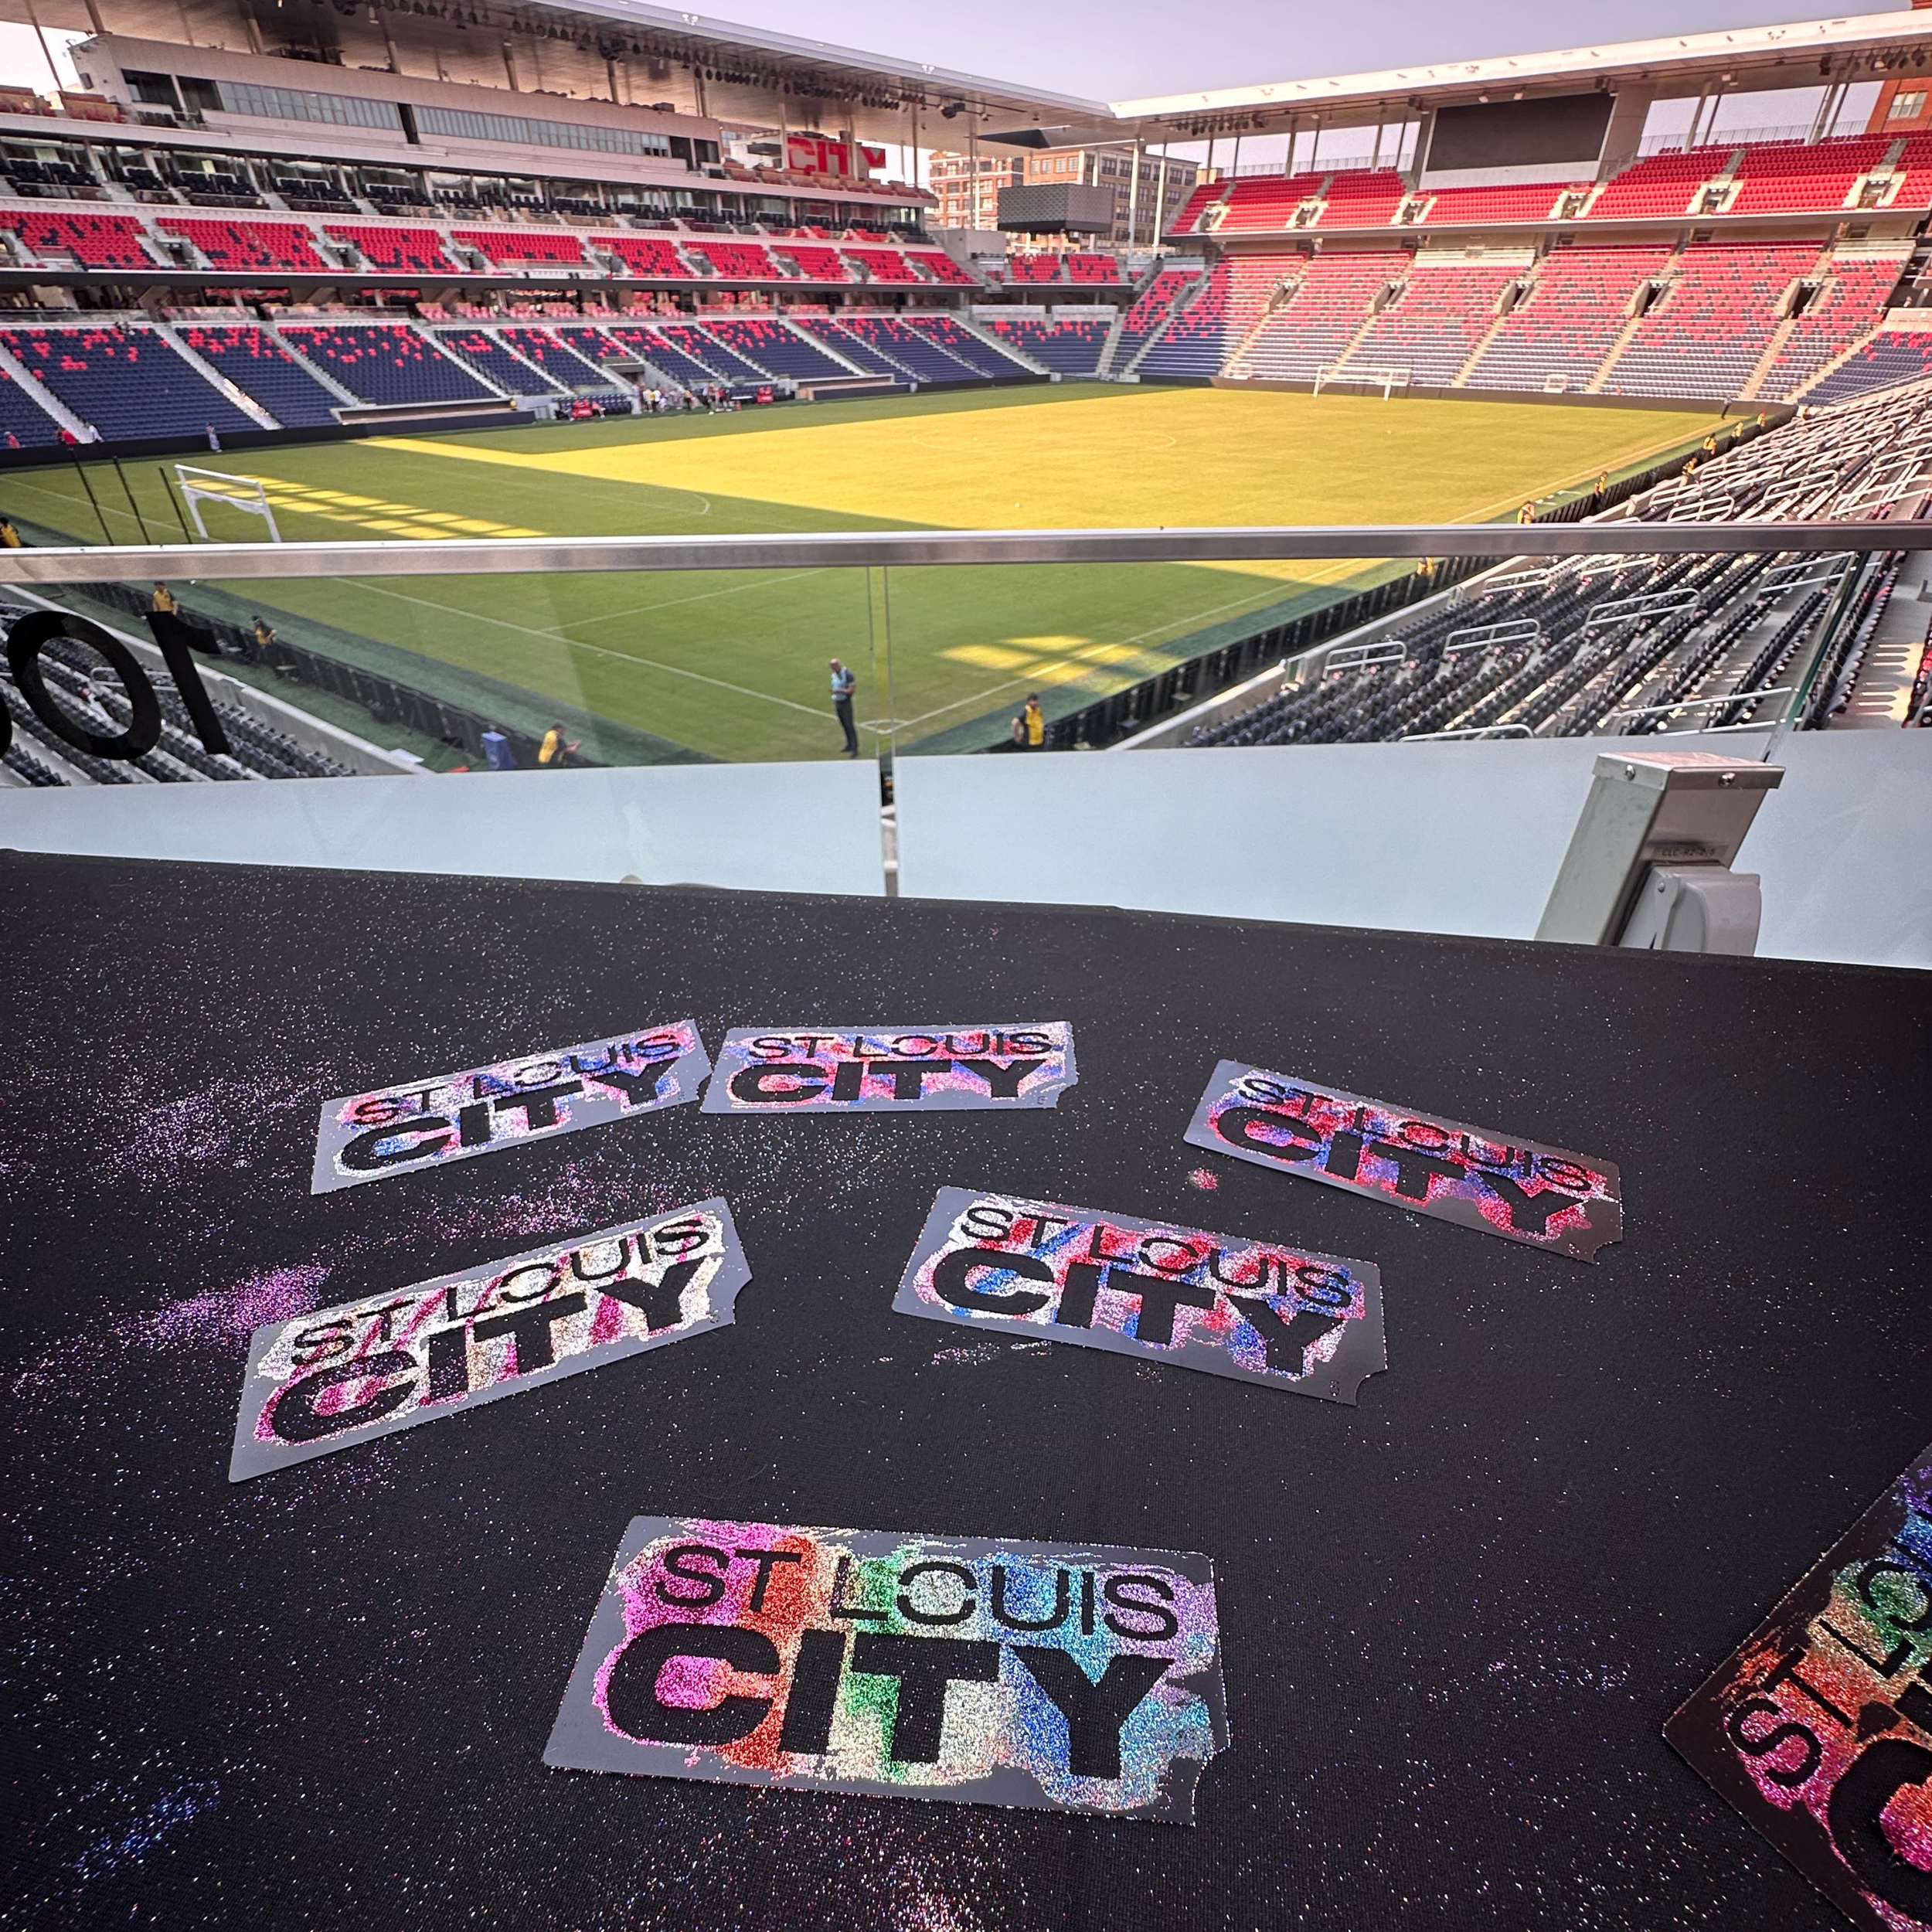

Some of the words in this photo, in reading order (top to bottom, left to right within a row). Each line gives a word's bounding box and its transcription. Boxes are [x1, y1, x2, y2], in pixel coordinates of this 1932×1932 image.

[355, 1087, 444, 1124] ST
[474, 1034, 682, 1098] LOUIS
[732, 1059, 1048, 1103] CITY
[749, 1036, 833, 1059] ST
[854, 1032, 1052, 1056] LOUIS
[341, 1056, 682, 1169] CITY
[1238, 1078, 1332, 1114] ST
[1353, 1107, 1592, 1192] LOUIS
[1216, 1106, 1586, 1236] CITY
[291, 1300, 417, 1366] ST
[447, 1219, 709, 1322] LOUIS
[933, 1248, 1349, 1375] CITY
[961, 1206, 1070, 1247] ST
[1090, 1226, 1352, 1306] LOUIS
[272, 1255, 713, 1444] CITY
[652, 1546, 801, 1614] ST
[831, 1545, 1178, 1641] LOUIS
[607, 1623, 1179, 1780] CITY
[1727, 1645, 1853, 1788] ST
